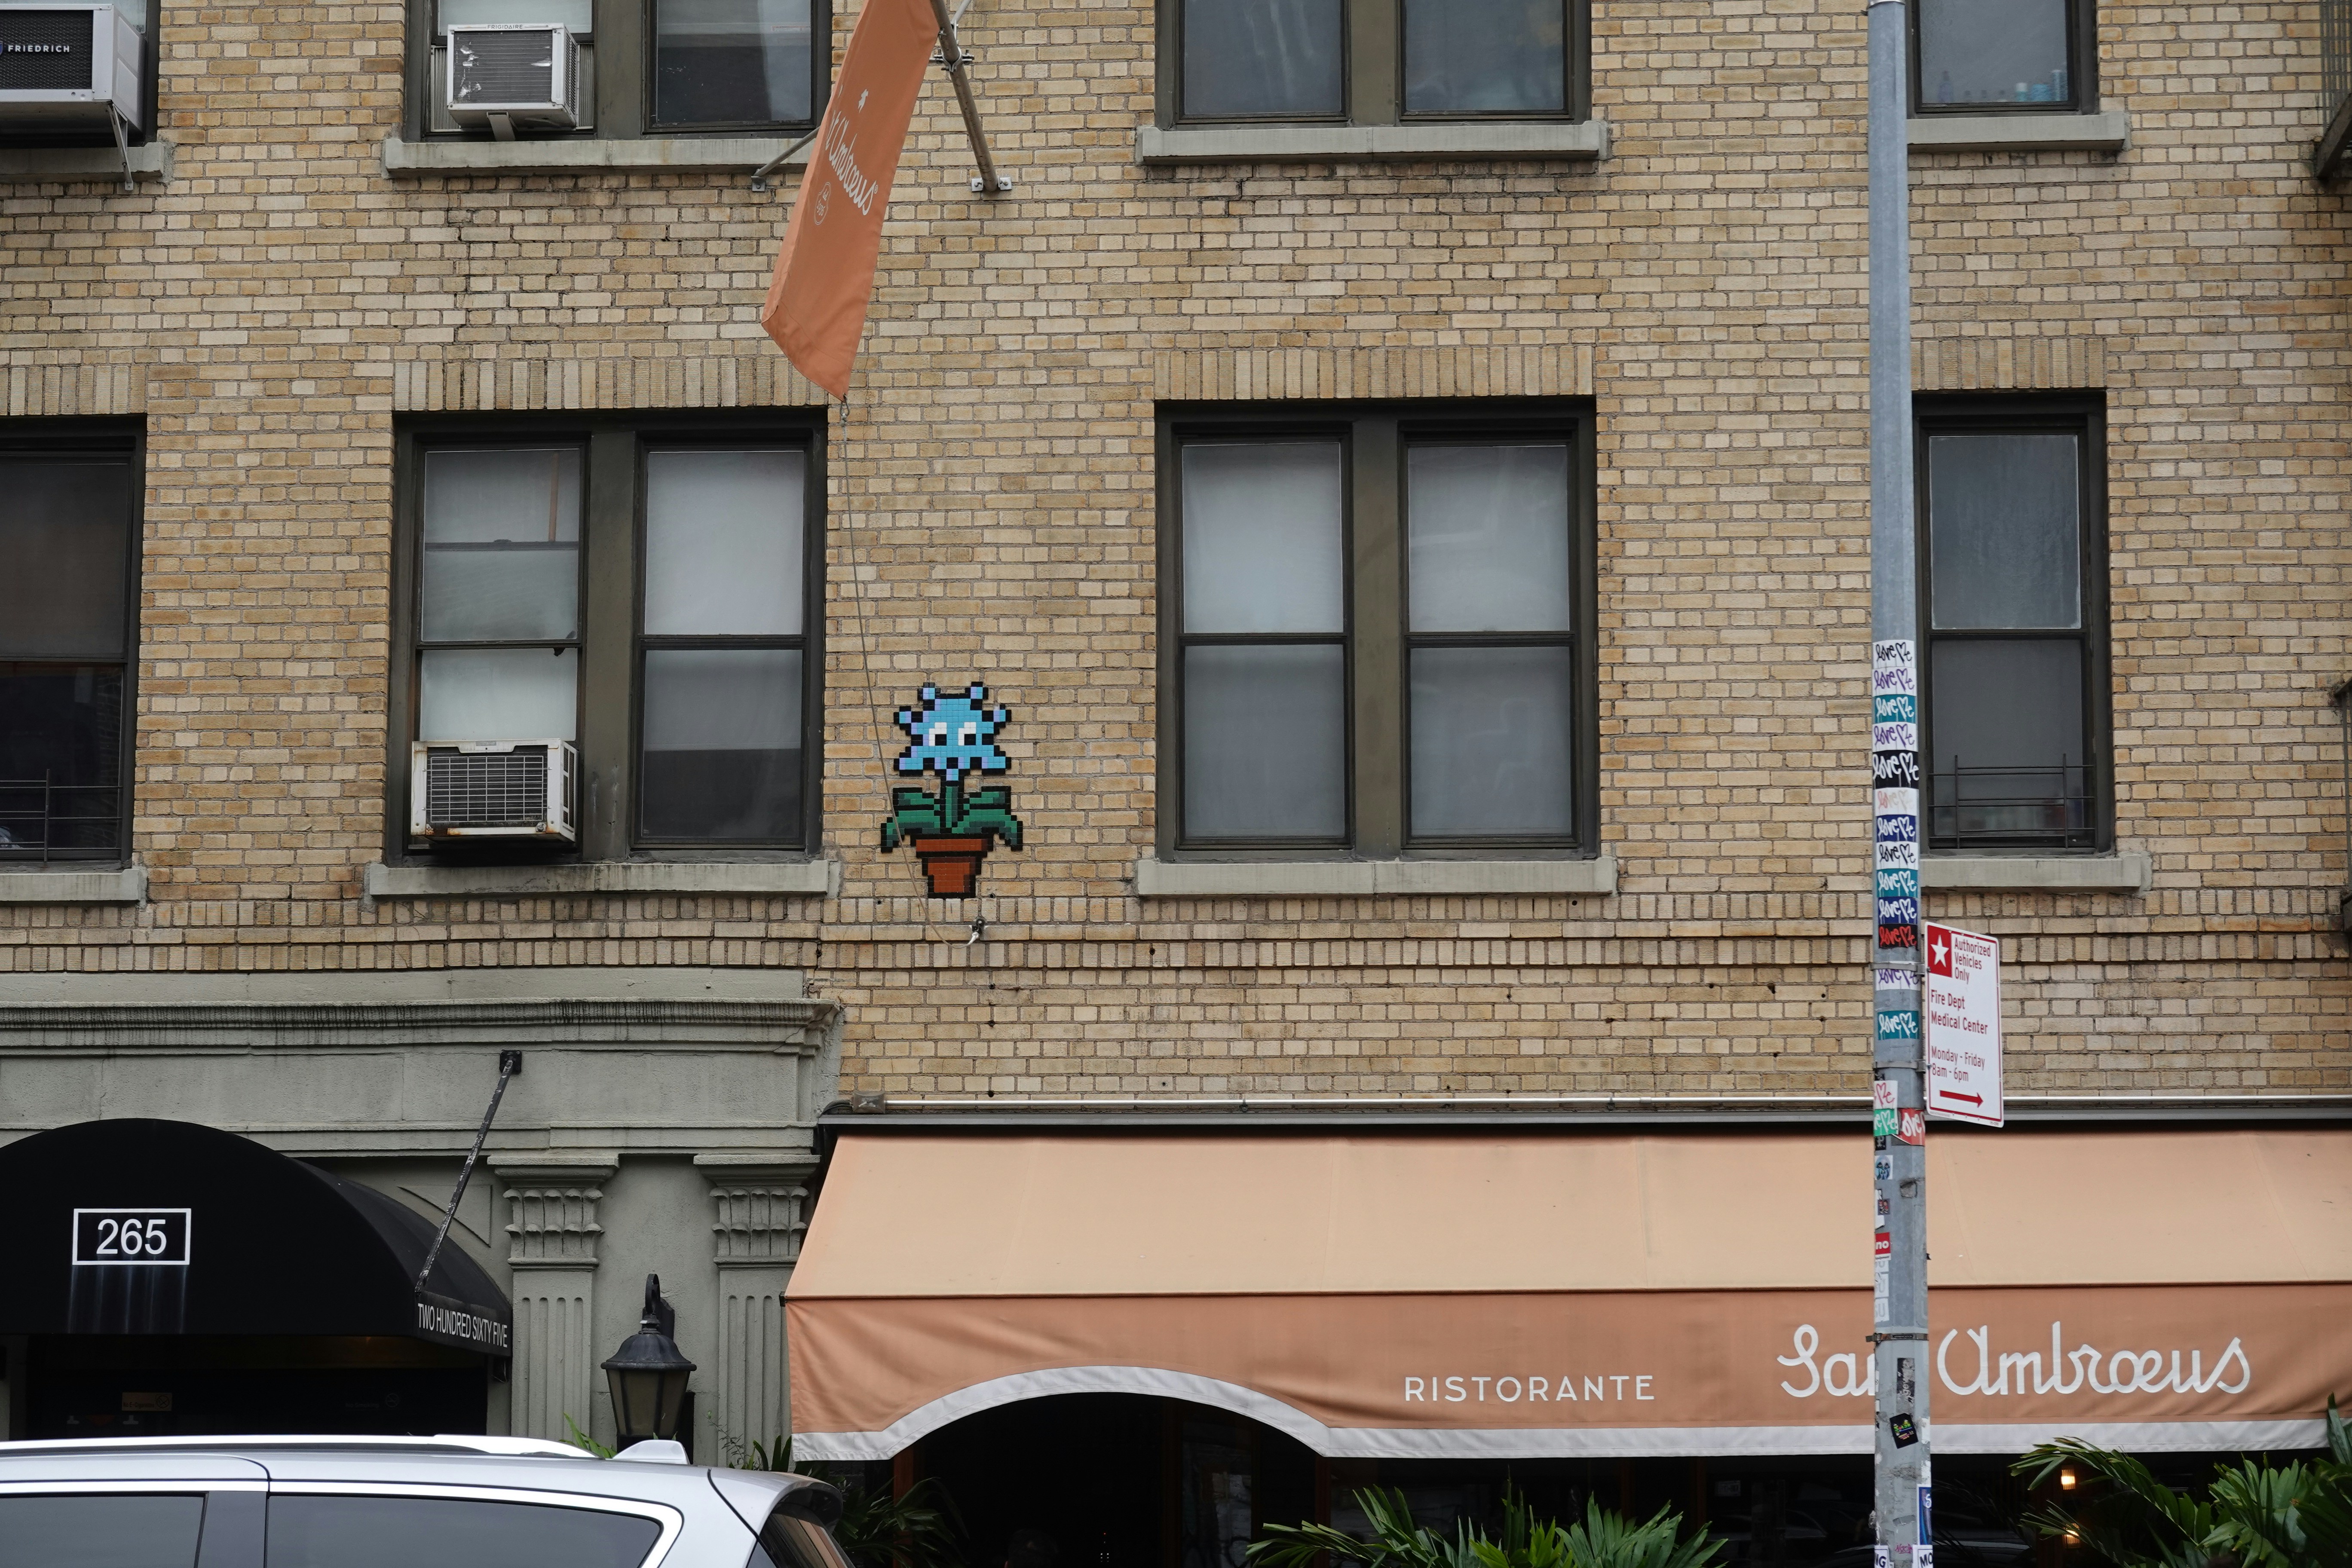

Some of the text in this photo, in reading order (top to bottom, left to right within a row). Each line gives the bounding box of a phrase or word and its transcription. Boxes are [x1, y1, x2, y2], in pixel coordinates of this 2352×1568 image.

[1954, 937, 1991, 957] Authorized
[1954, 952, 1982, 969] Vehicles
[1955, 967, 1969, 984] Only
[1931, 989, 1965, 1011] Fire Dept
[1931, 1011, 1988, 1035] Medical Center
[1931, 1046, 1958, 1065] Monday
[1964, 1052, 1985, 1071] Friday
[1932, 1063, 1947, 1078] 8am
[1954, 1068, 1969, 1083] 6pm
[96, 1219, 166, 1255] 265
[418, 1303, 507, 1348] TWO HUNDRED SIXTY FIVE
[1405, 1375, 1654, 1402] RISTORANTE
